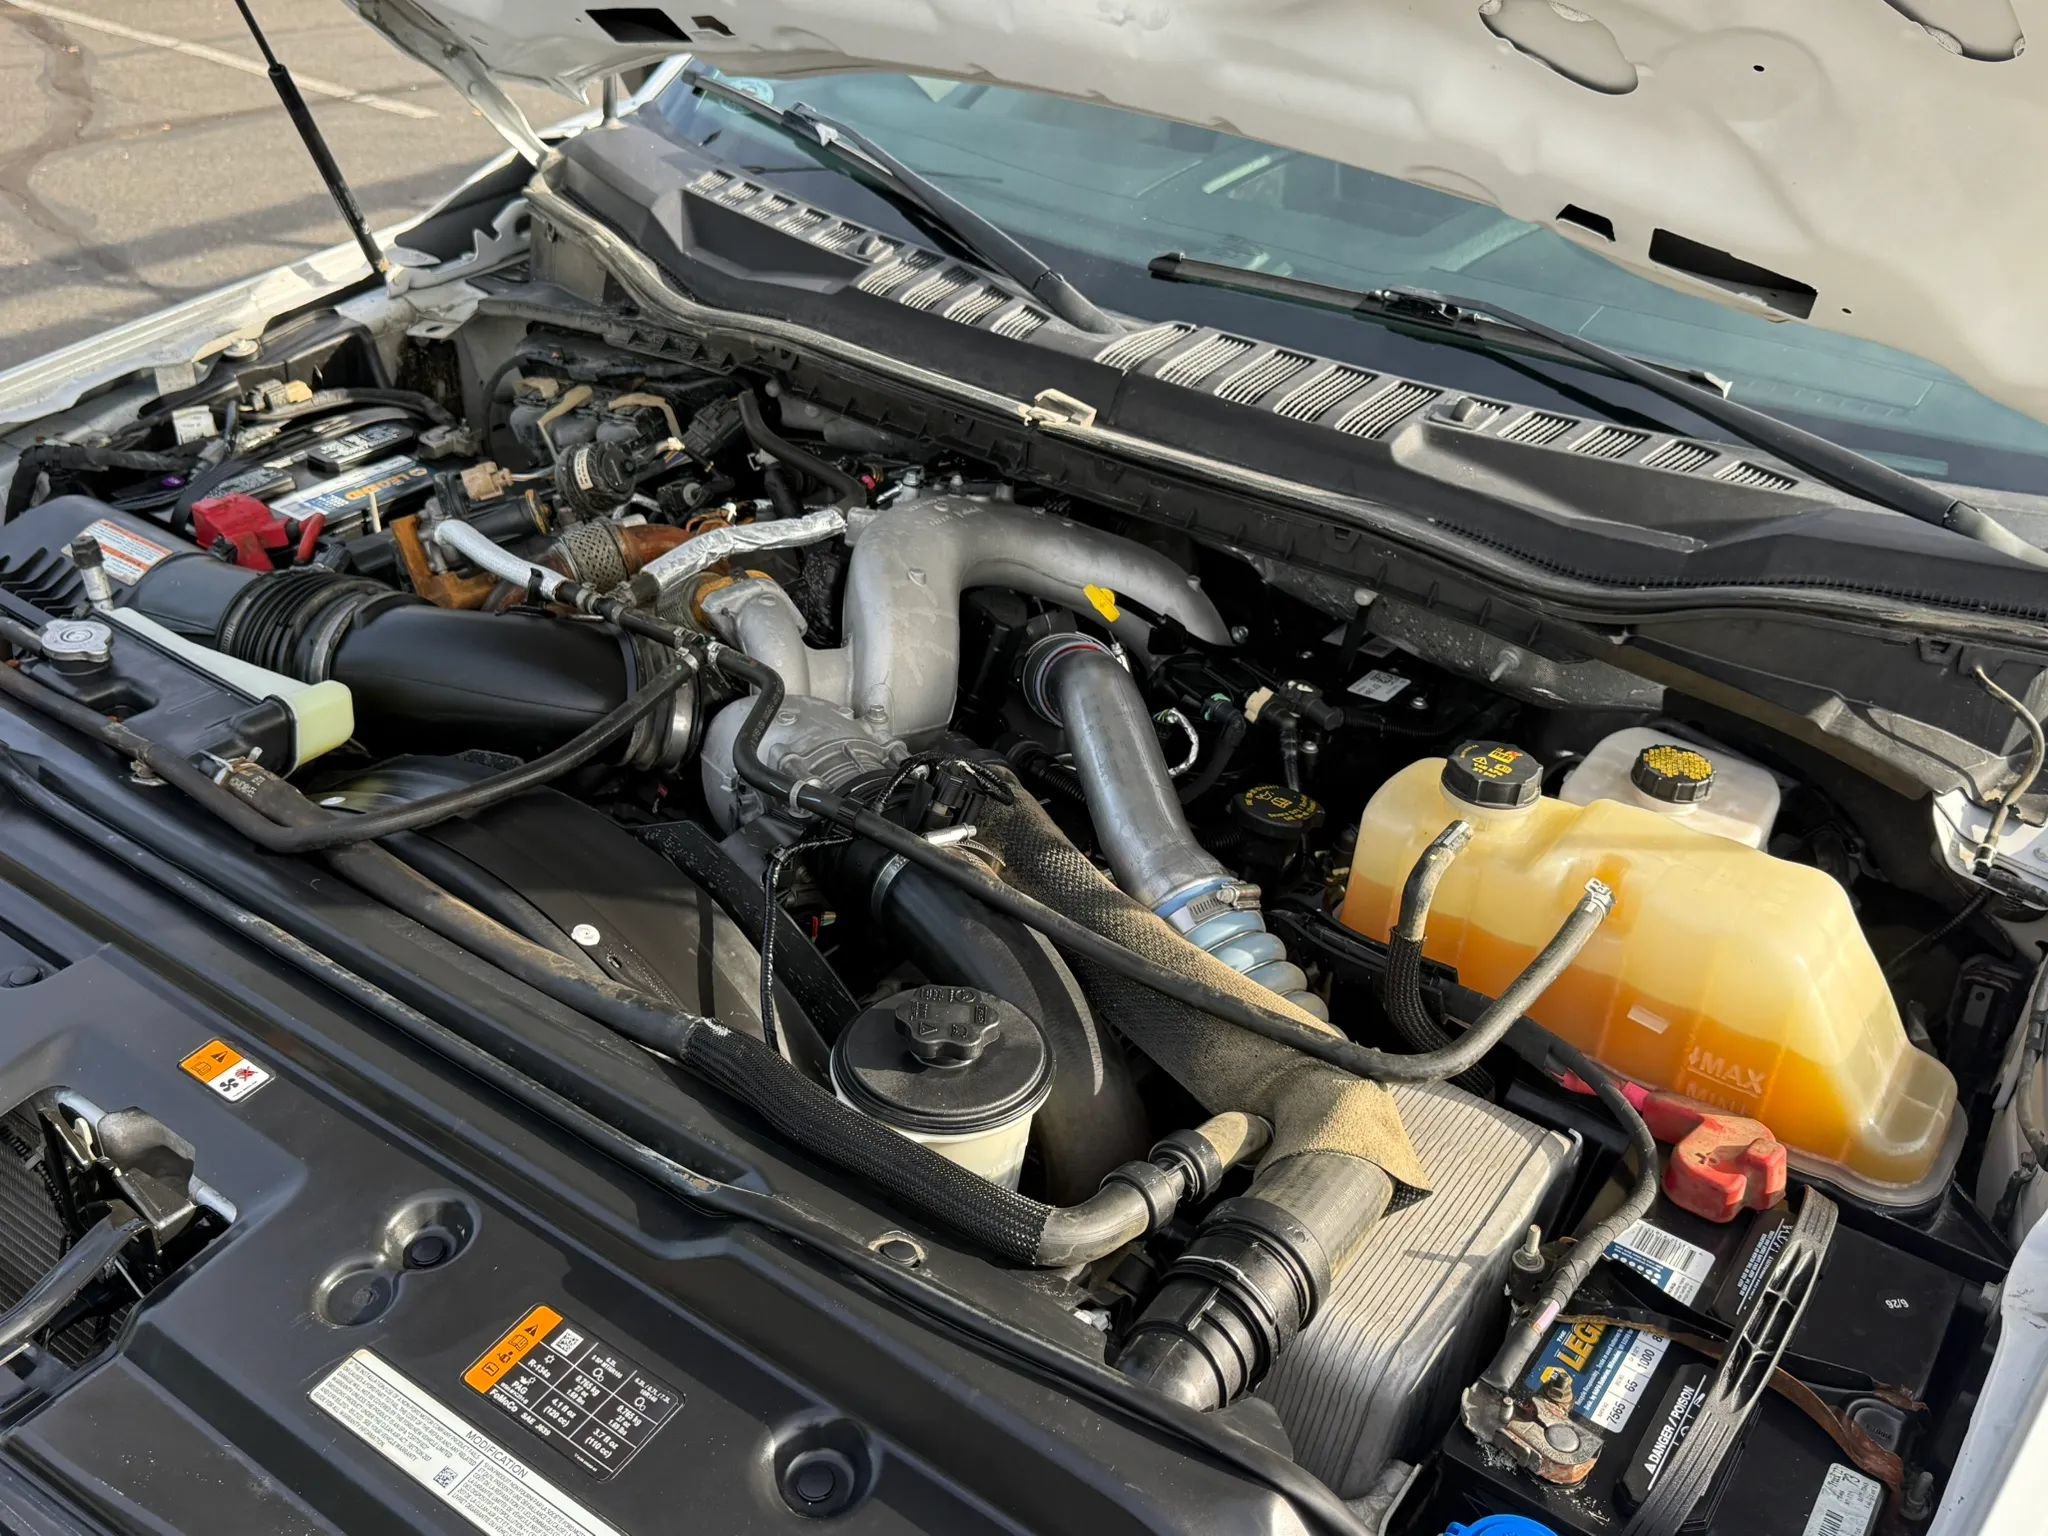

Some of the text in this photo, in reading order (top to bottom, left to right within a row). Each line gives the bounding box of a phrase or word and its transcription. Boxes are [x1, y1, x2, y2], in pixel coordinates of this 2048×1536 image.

[1699, 1049, 1767, 1095] MAX
[1555, 1329, 1567, 1343] THE
[526, 1357, 553, 1379] R-134a
[1636, 1347, 1655, 1370] 1000
[509, 1379, 529, 1395] PAG
[572, 1384, 589, 1398] 27 oz
[574, 1373, 602, 1397] 0.765 kg
[1623, 1378, 1638, 1393] 65
[549, 1396, 577, 1419] 4.1 fl oz
[574, 1395, 587, 1405] lbs
[487, 1387, 553, 1437] FoMoCo SAE J639
[542, 1404, 571, 1428] (120 cc)
[614, 1414, 631, 1428] 27 oz
[615, 1403, 643, 1427] 0.765 kg
[1605, 1400, 1626, 1425] 7565
[1647, 1423, 1675, 1463] DANGER
[1669, 1384, 1695, 1419] POISON
[418, 1412, 434, 1425] MOTOR
[431, 1422, 452, 1438] COMPANY
[449, 1436, 469, 1451] PRODUCT
[591, 1427, 619, 1450] 3.7 fl oz
[616, 1425, 629, 1436] lbs
[420, 1433, 438, 1447] VEHICLE
[434, 1444, 453, 1458] LIMITED
[464, 1430, 529, 1478] MODIFICATION
[583, 1434, 613, 1459] (110 cc)
[456, 1451, 477, 1466] RELATED
